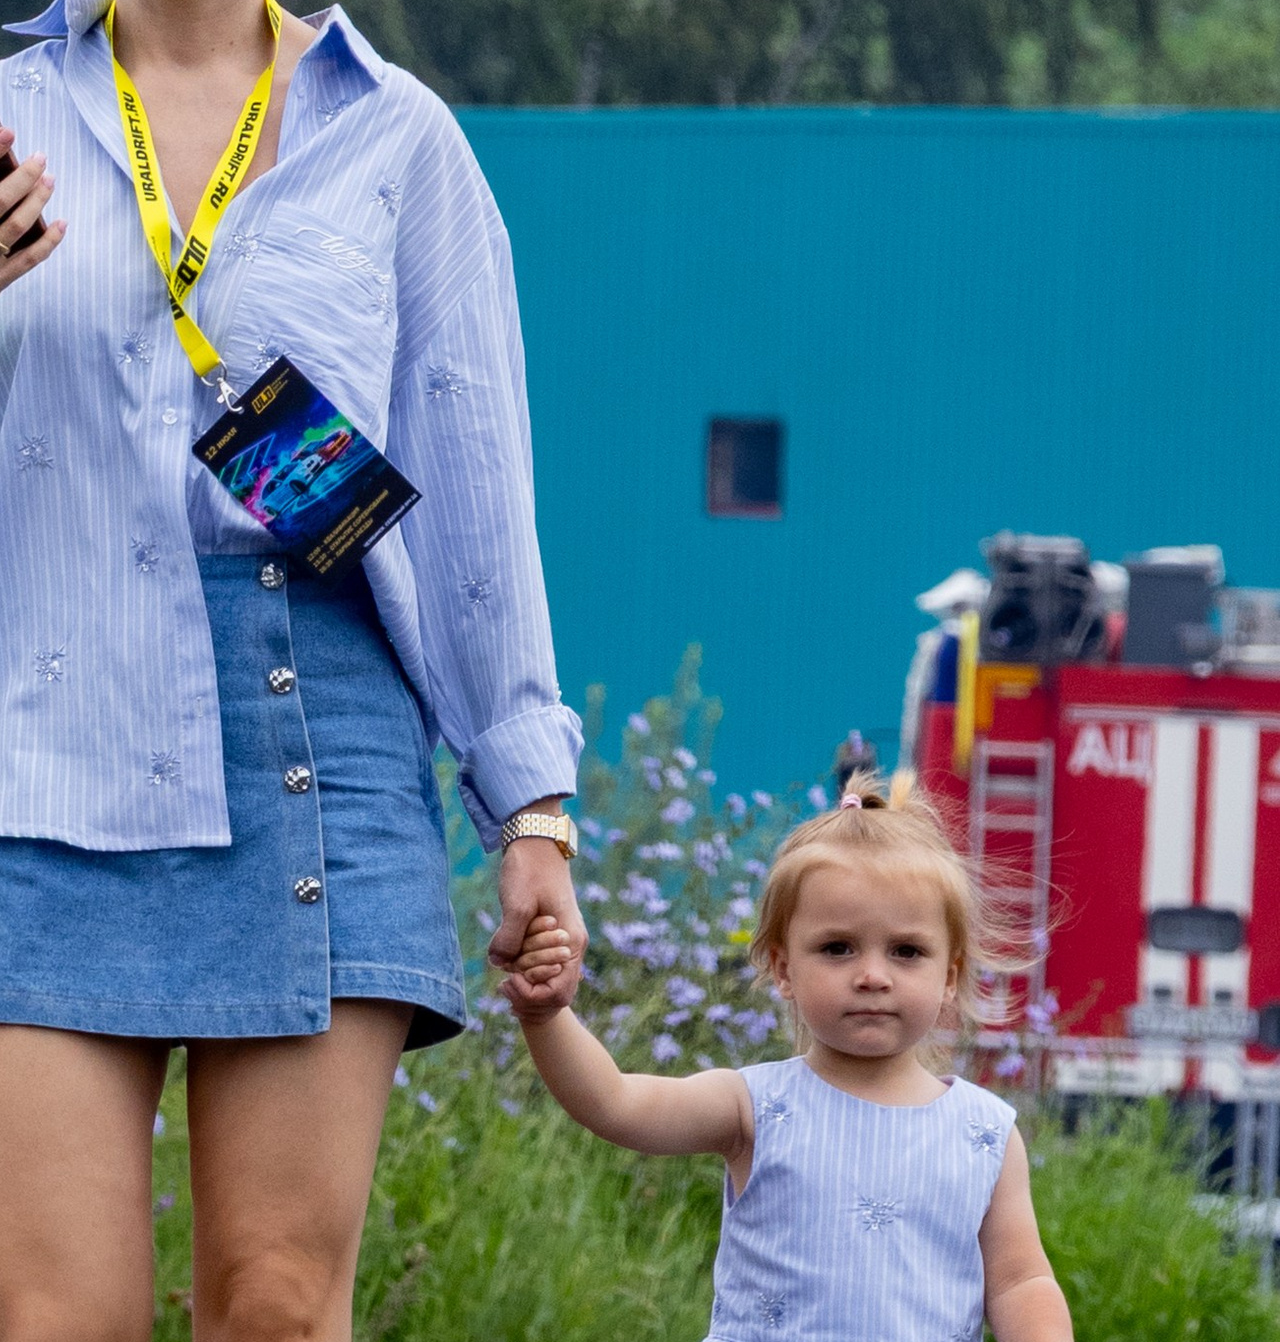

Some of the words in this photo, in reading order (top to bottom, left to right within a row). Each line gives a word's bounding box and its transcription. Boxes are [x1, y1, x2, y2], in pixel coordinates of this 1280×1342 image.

[123, 91, 157, 202] URALDRIFT.RU
[210, 101, 262, 210] URALDRIFT.RU
[177, 235, 208, 286] ULD
[253, 387, 275, 413] ULD
[205, 445, 218, 461] 12
[1067, 721, 1153, 785] АЦ
